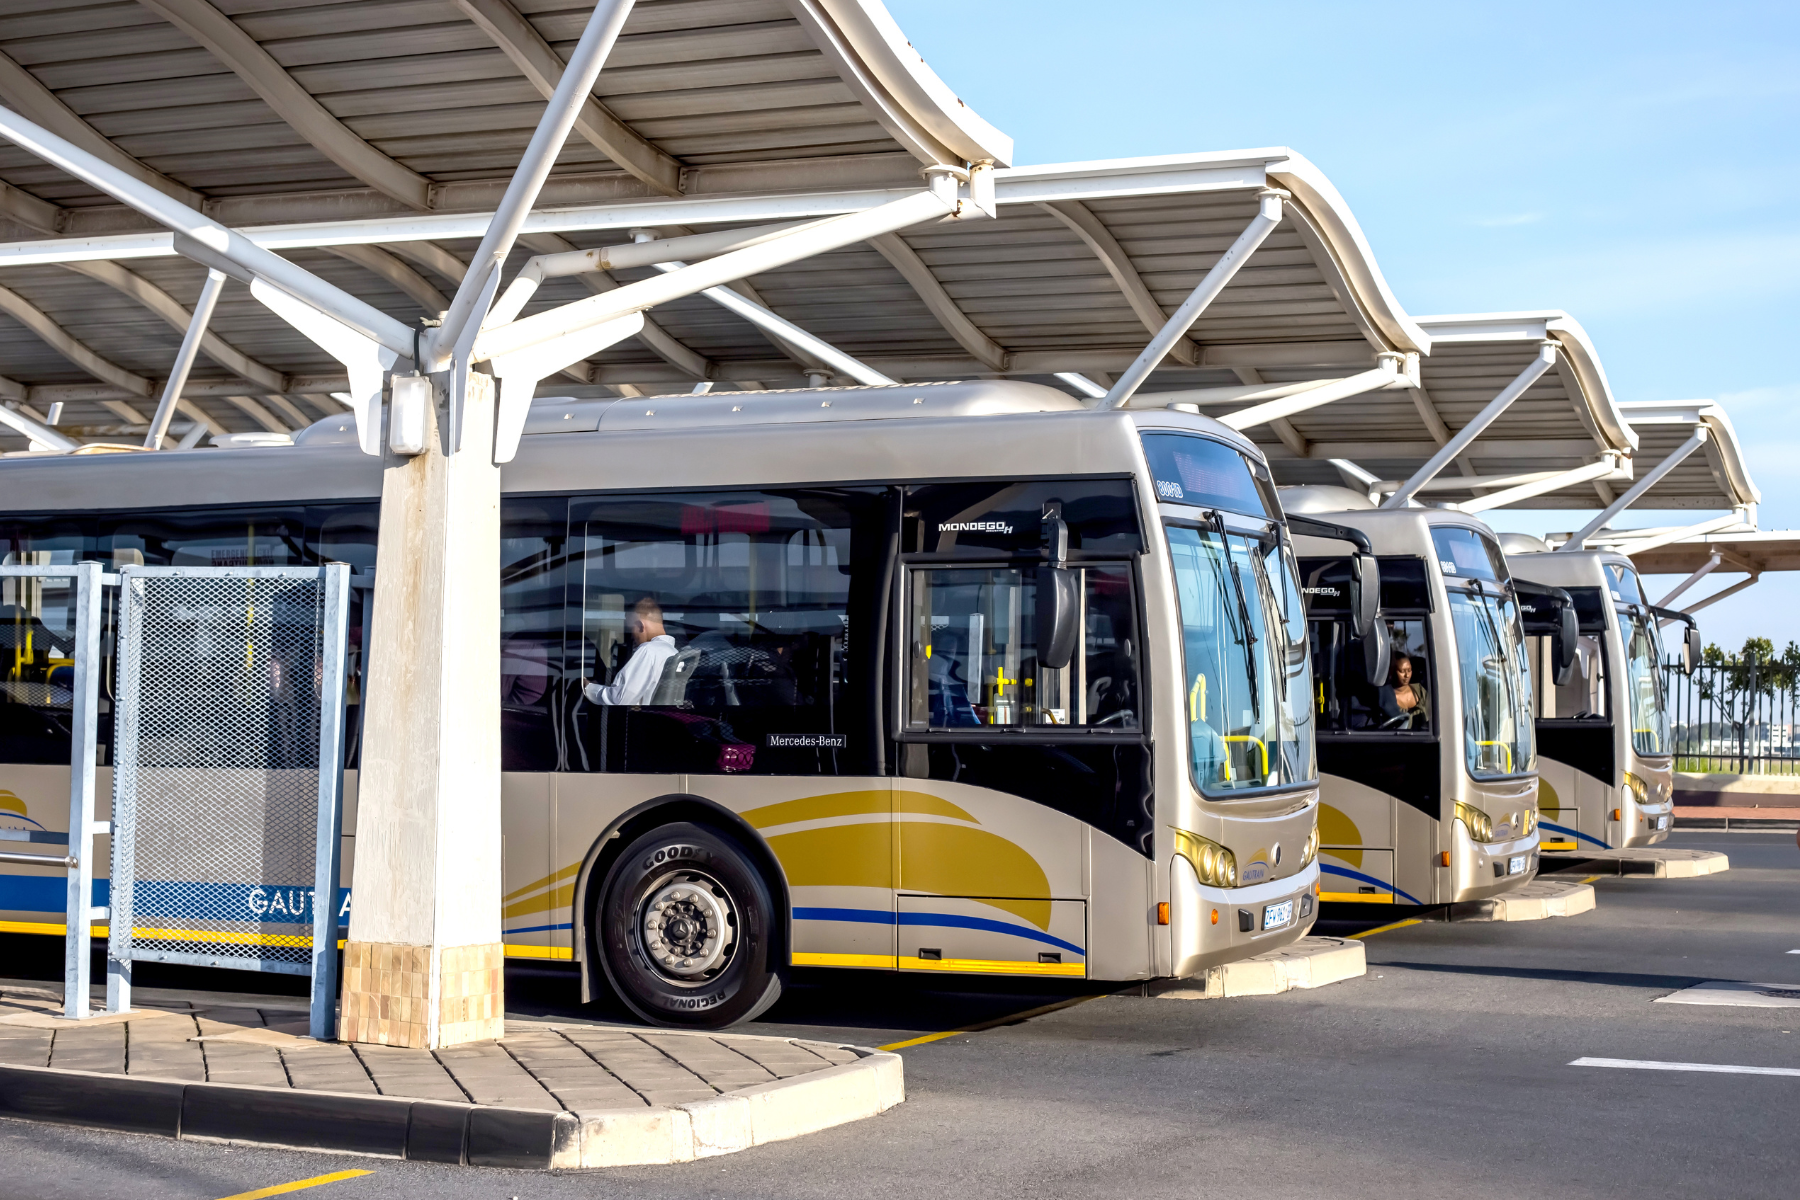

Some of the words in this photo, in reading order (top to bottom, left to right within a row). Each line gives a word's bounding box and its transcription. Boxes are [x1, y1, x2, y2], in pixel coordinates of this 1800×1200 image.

[938, 521, 1005, 532] MONDEGO
[211, 549, 249, 560] EMERGENC
[770, 735, 843, 747] Mercedes-Benz
[1242, 869, 1264, 881] GAUTRAIN
[662, 989, 727, 1009] REGIONAL
